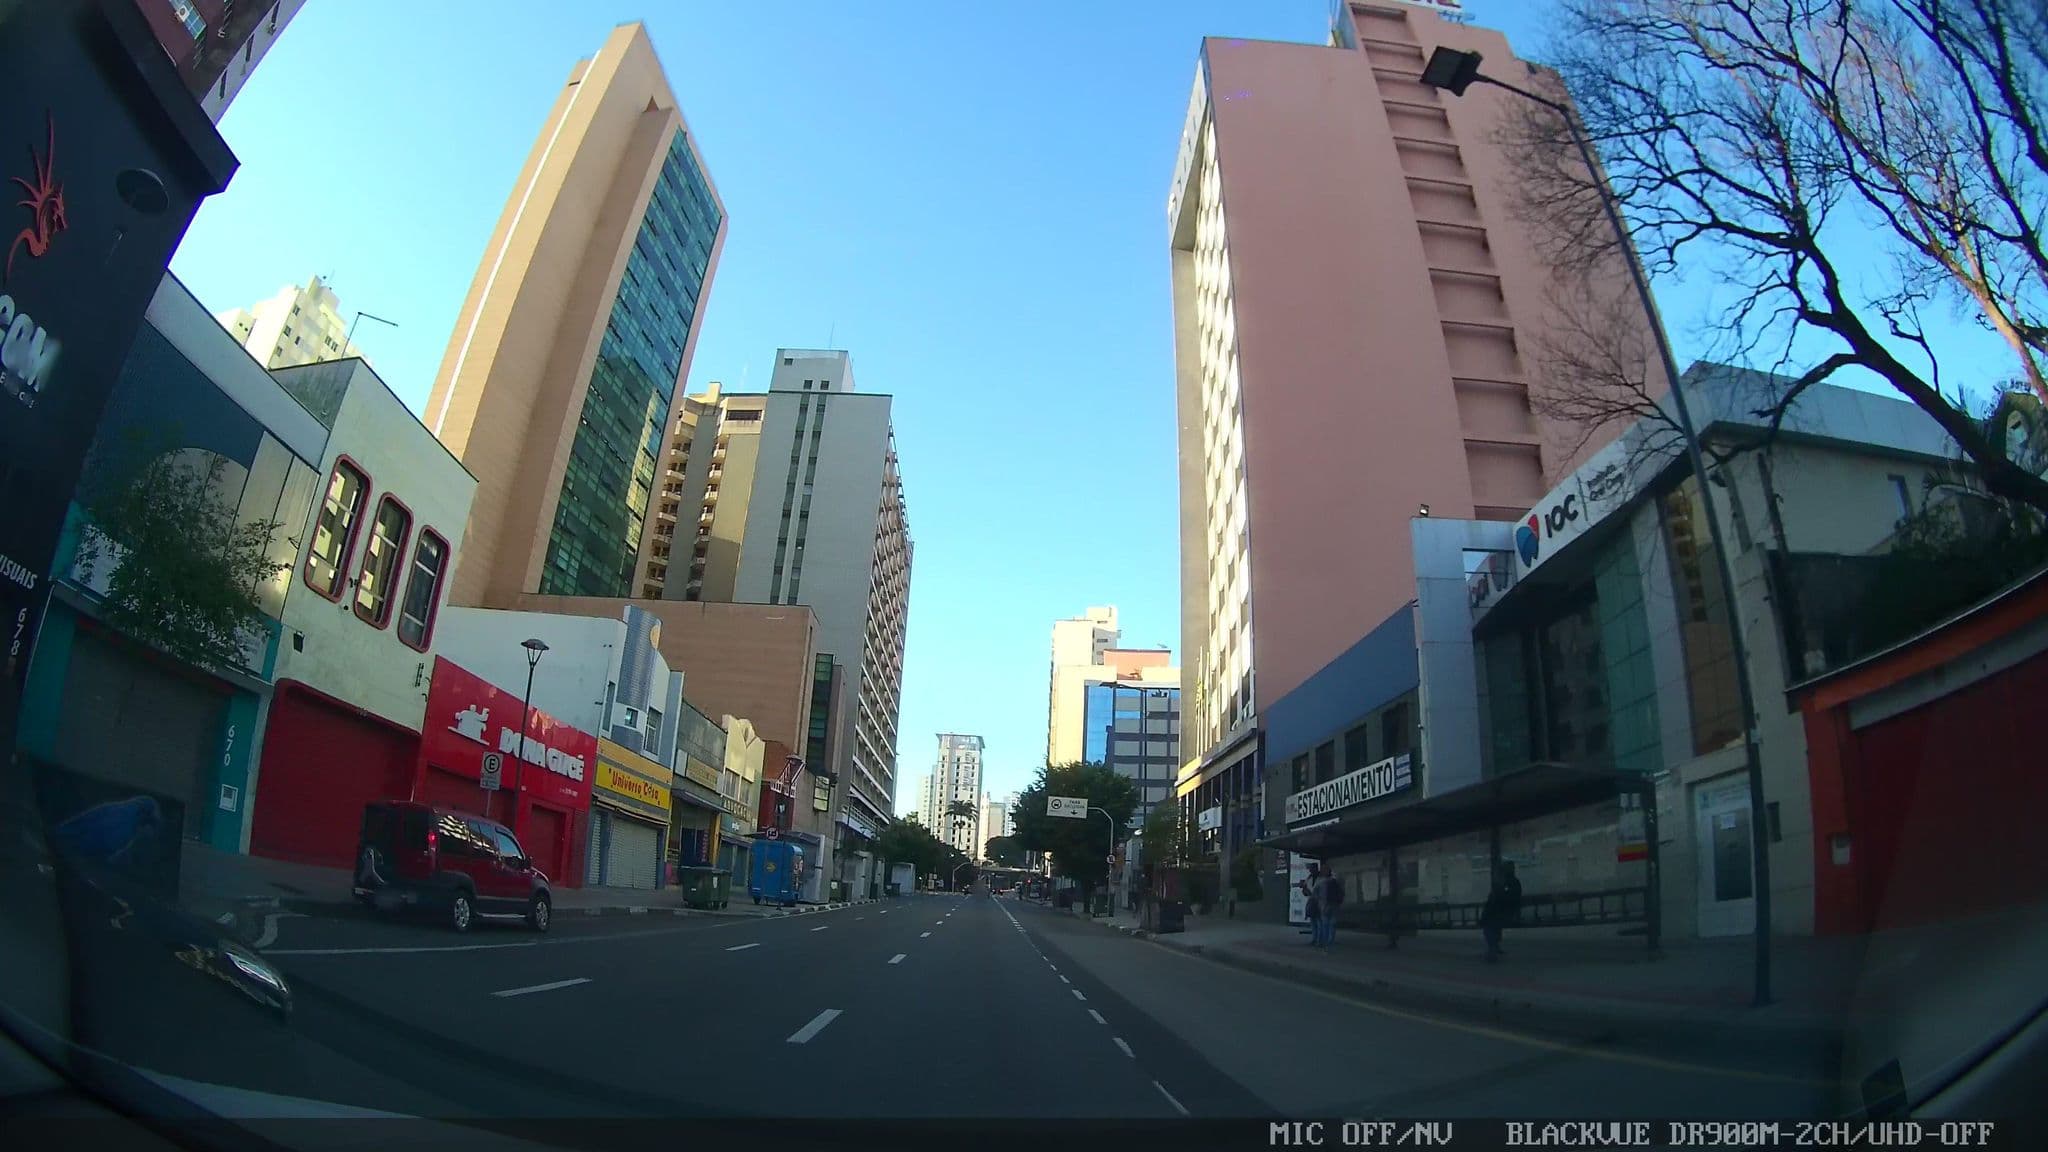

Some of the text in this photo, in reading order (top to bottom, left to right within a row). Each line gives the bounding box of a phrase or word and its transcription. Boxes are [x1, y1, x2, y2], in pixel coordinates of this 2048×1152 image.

[1544, 494, 1579, 538] IOC
[0, 554, 38, 589] ISUAIS
[11, 607, 27, 656] 678
[224, 725, 236, 766] 670
[1297, 762, 1393, 819] ESTACIONAMENTO
